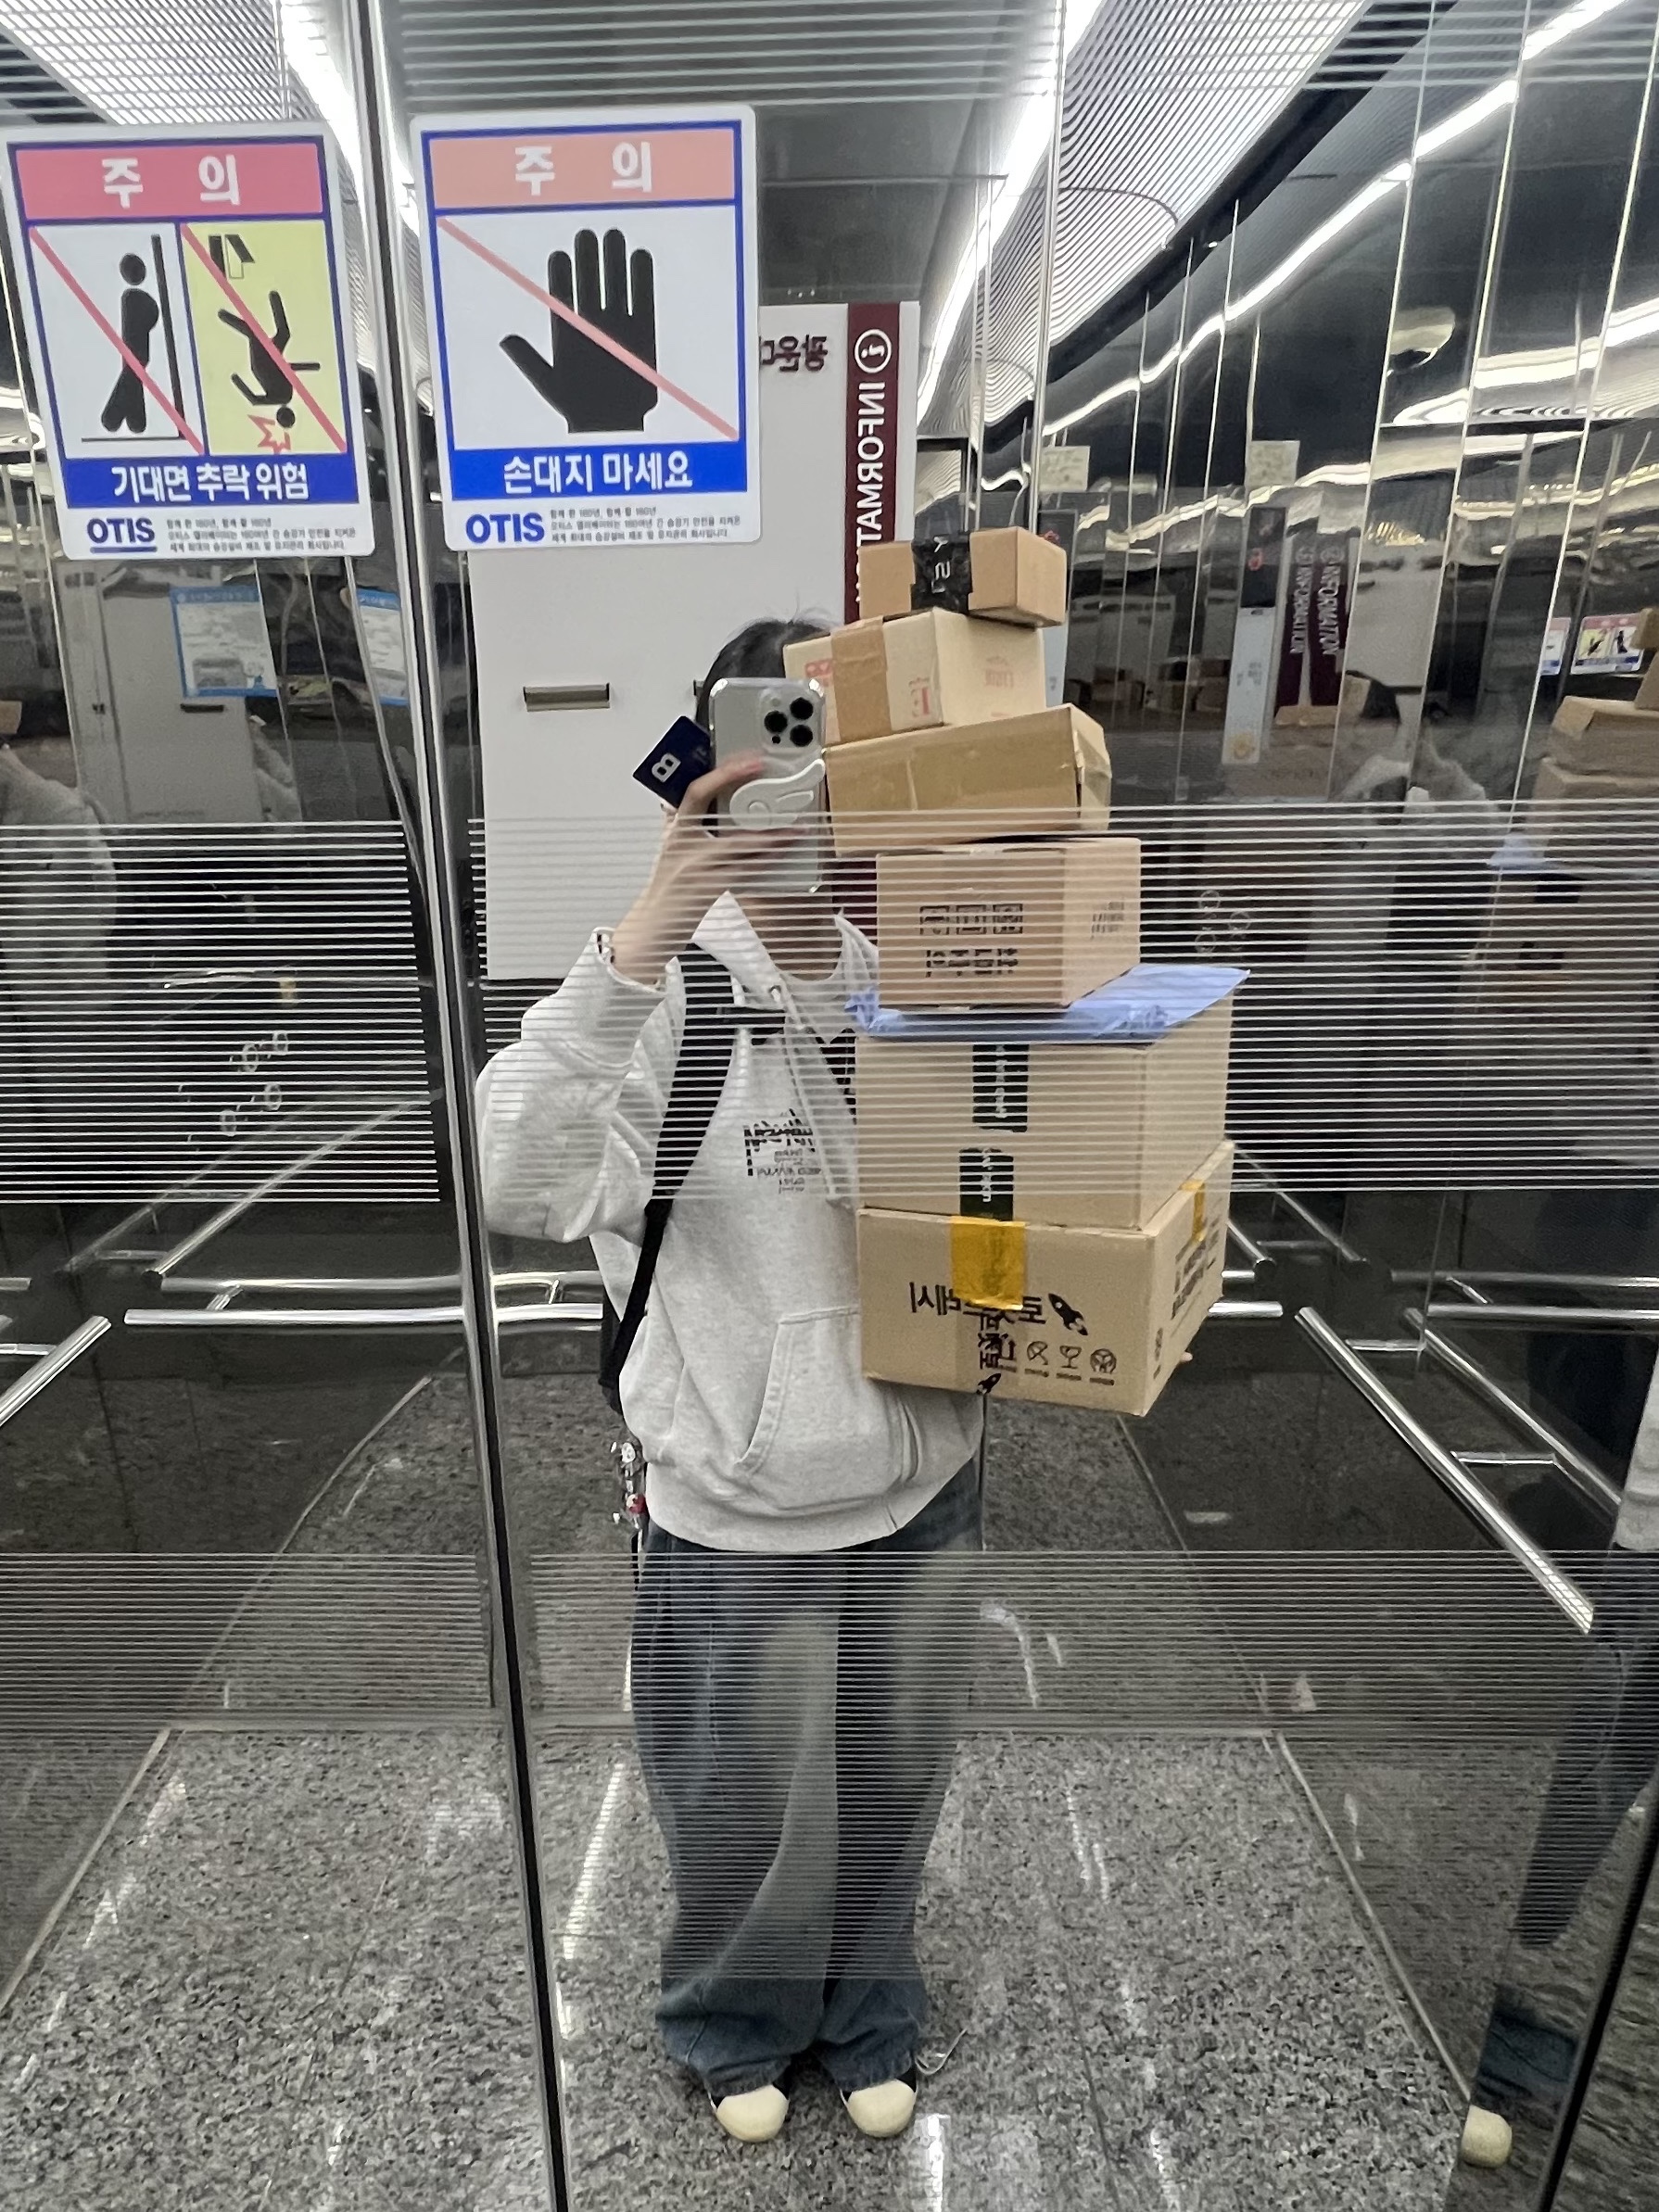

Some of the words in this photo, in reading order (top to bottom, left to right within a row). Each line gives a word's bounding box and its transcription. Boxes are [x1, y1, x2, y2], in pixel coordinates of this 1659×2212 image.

[111, 465, 190, 503] 기대면
[196, 463, 250, 501] 추락
[256, 462, 310, 500] 위험
[502, 452, 594, 495] 손대지
[602, 450, 693, 492] 마세요
[86, 517, 156, 544] OTIS
[465, 512, 545, 544] OTIS
